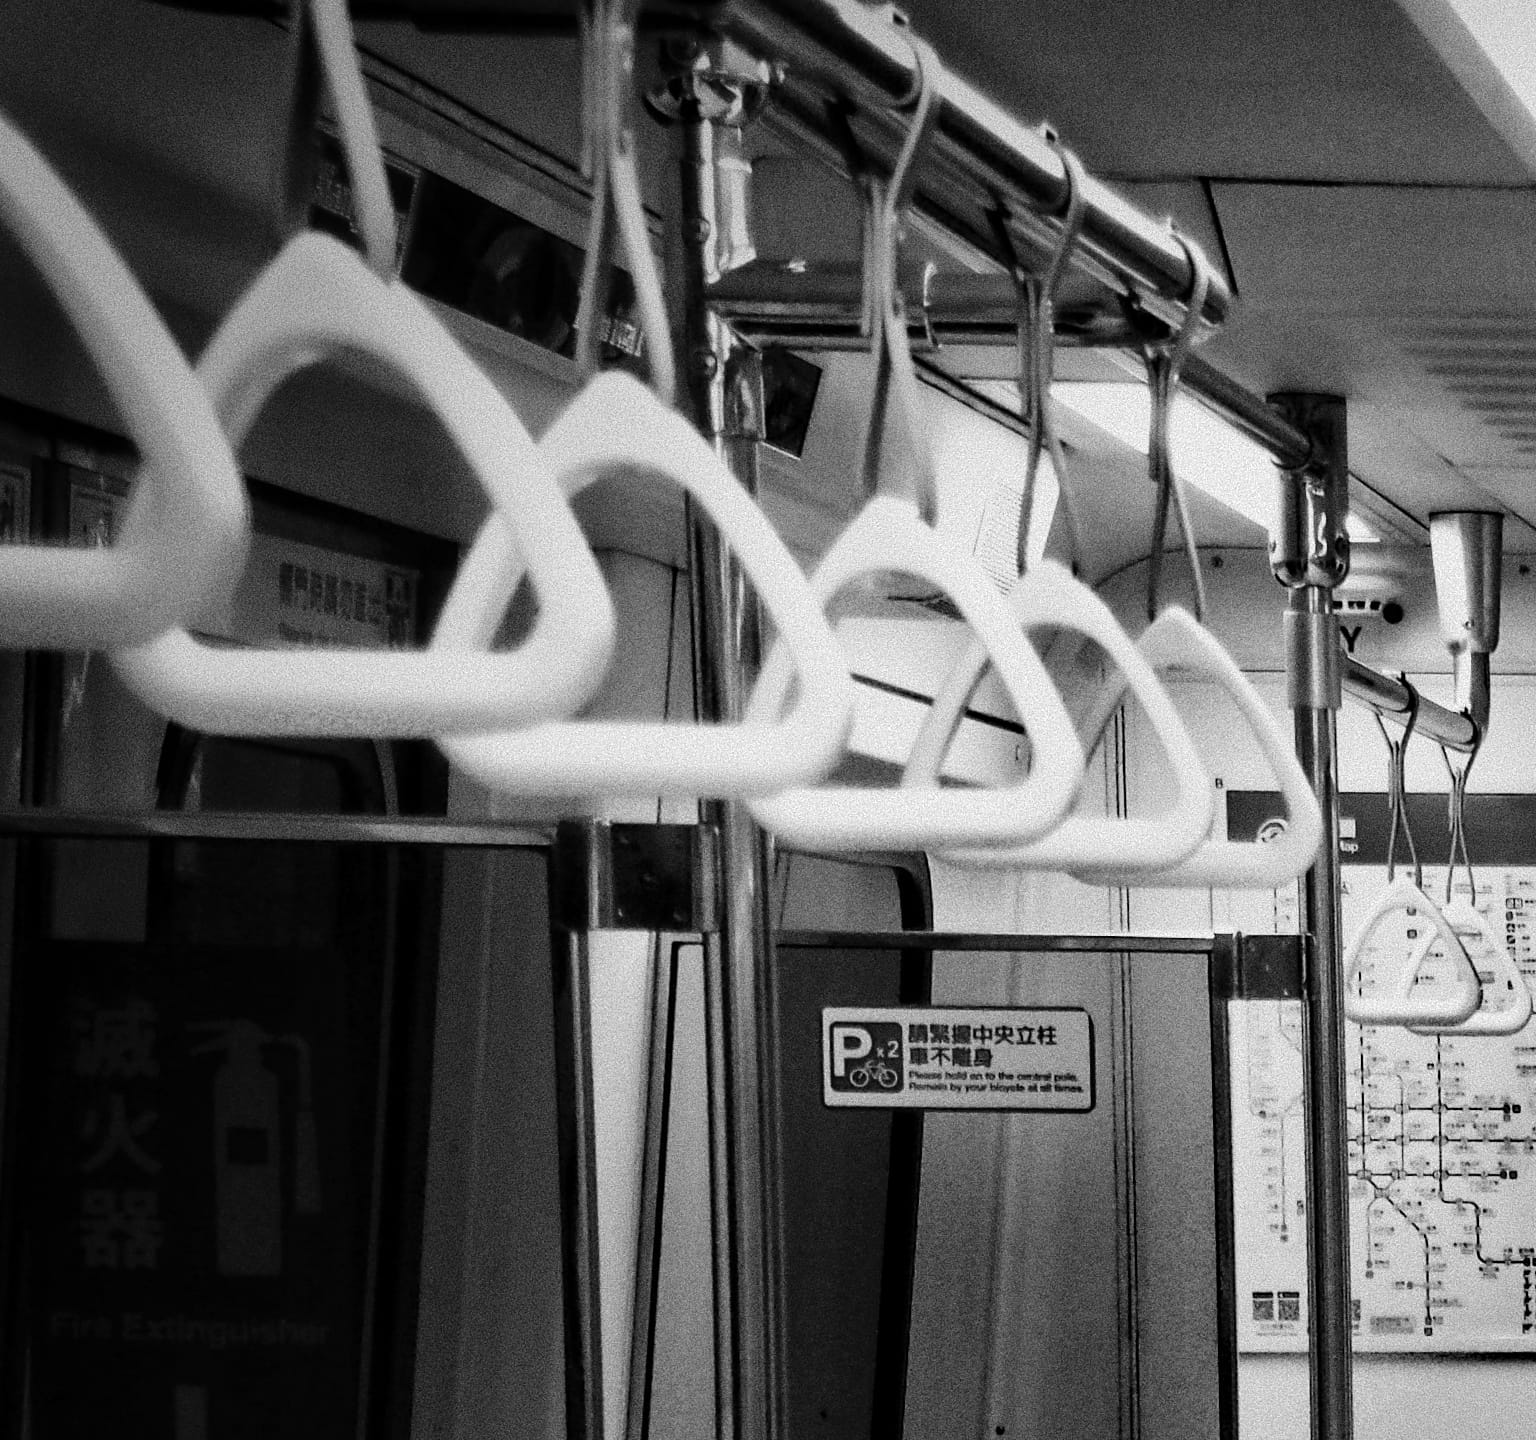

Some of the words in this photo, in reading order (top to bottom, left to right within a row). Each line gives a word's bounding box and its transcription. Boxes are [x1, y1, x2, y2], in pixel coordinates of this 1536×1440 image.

[909, 1070, 942, 1081] Please
[945, 1071, 967, 1081] hold
[998, 1072, 1014, 1081] the
[950, 1083, 962, 1093] by
[965, 1084, 987, 1093] your
[990, 1084, 1025, 1093] bicycle
[70, 990, 165, 1271] 滅火器
[50, 1309, 113, 1340] Fire
[121, 1311, 331, 1350] Extinguisher
